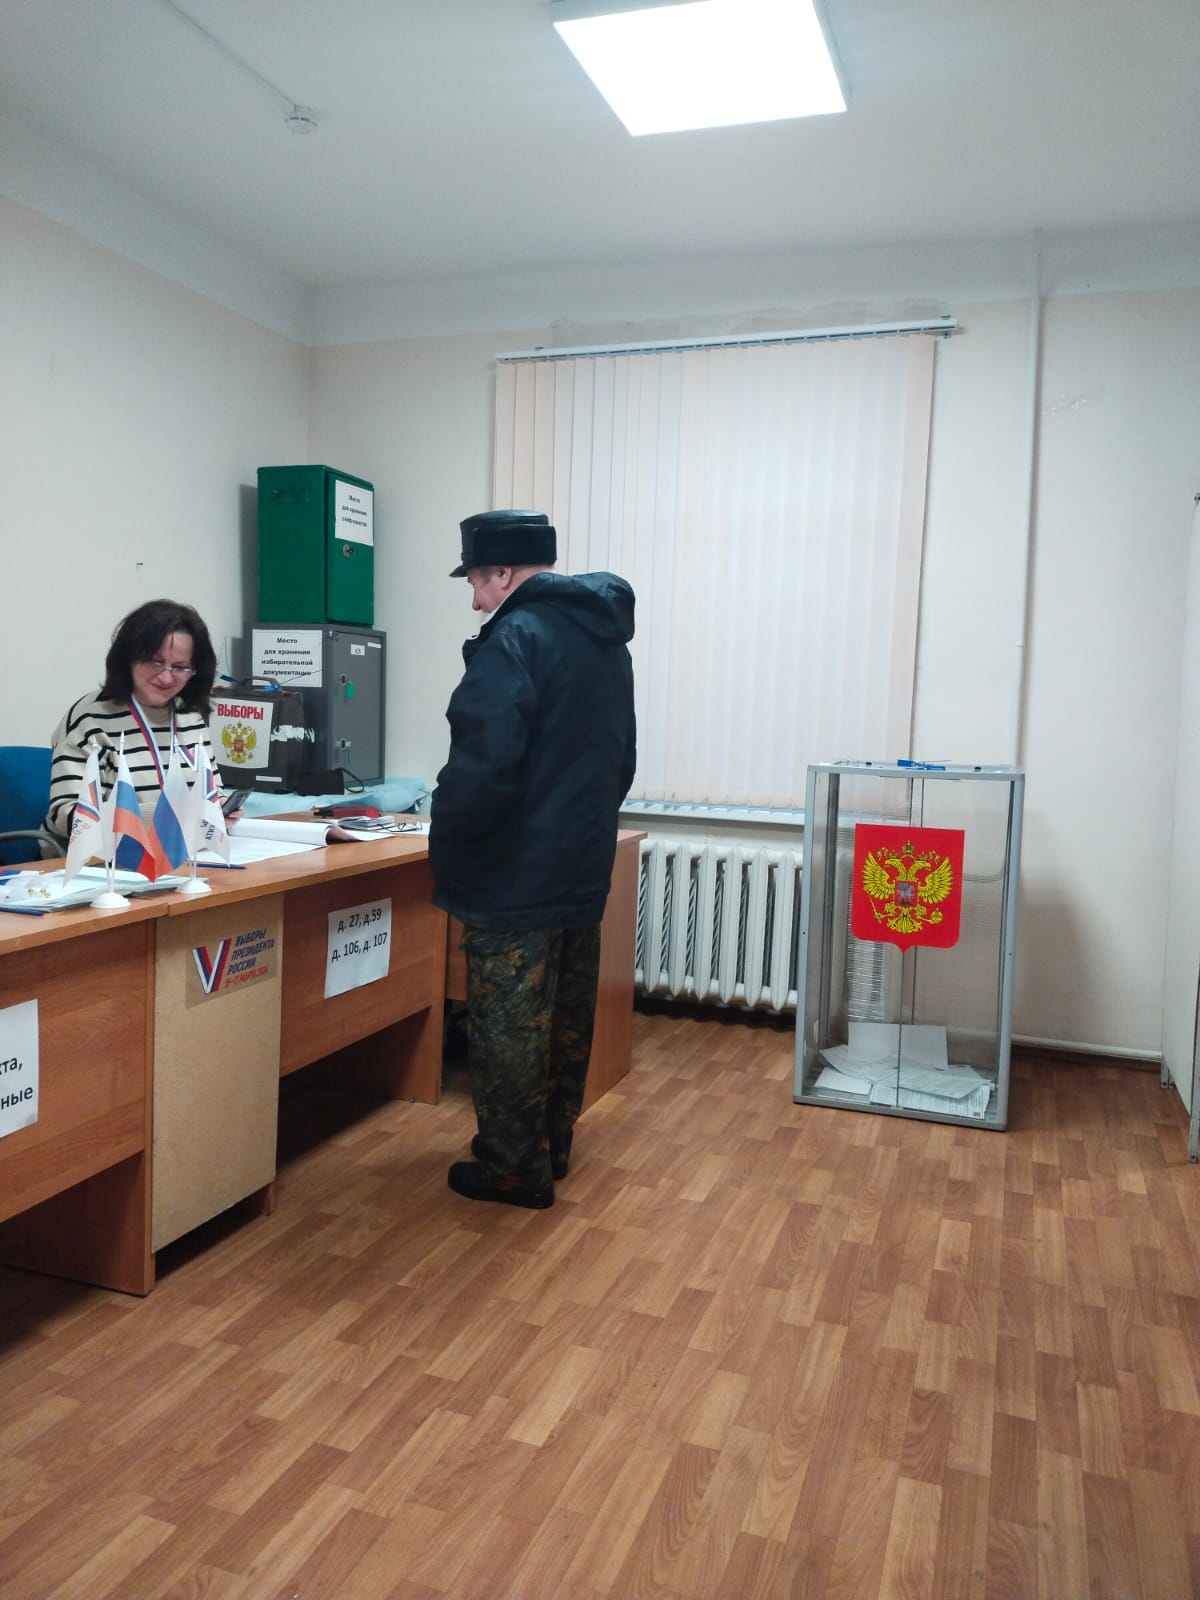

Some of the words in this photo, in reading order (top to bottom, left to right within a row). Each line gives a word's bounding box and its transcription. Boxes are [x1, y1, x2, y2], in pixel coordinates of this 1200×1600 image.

[261, 658, 314, 666] избирательной
[262, 669, 312, 677] документации
[217, 703, 264, 721] ВЫБОРЫ
[349, 913, 362, 929] 27,
[235, 928, 268, 947] ВЫБОРЫ
[231, 938, 275, 962] ПРЕЗИДЕНТА
[331, 949, 341, 963] д.
[343, 940, 361, 957] 106,
[362, 940, 371, 954] д.
[373, 932, 388, 948] 107
[227, 957, 256, 976] РОССИИ
